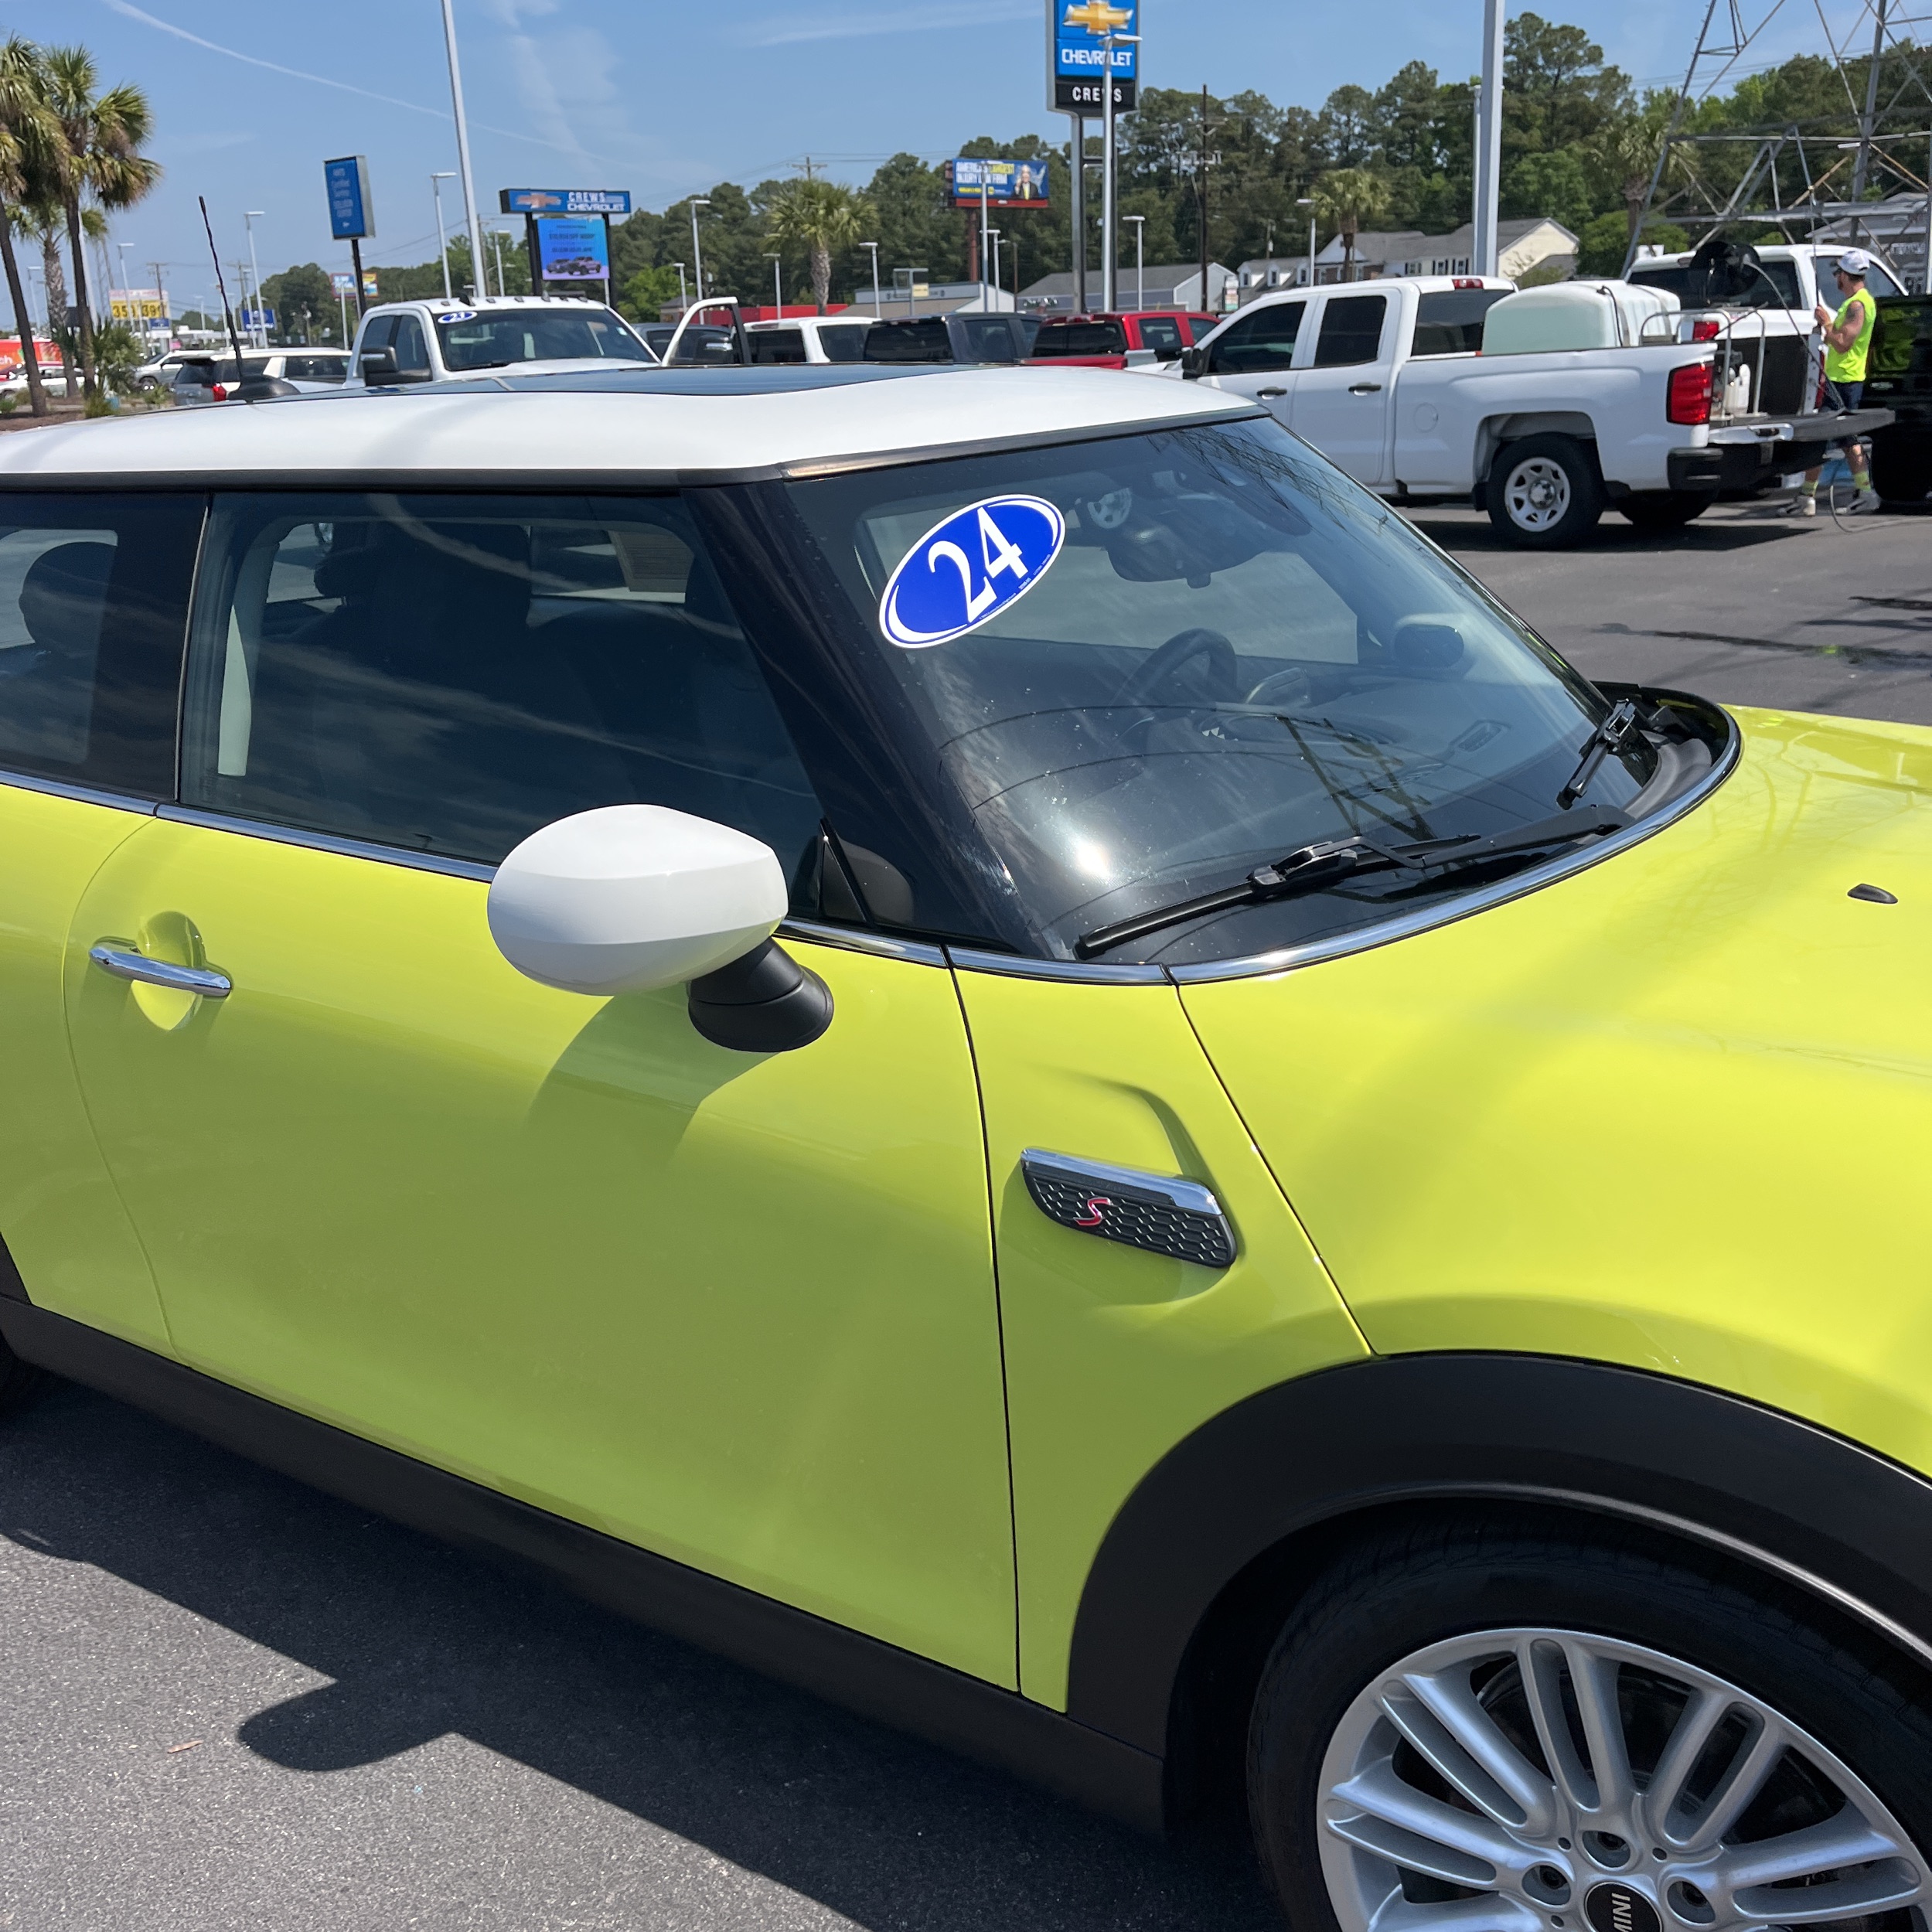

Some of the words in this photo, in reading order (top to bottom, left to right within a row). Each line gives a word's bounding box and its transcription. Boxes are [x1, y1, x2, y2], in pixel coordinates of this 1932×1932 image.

[1061, 49, 1132, 66] CHEVRLET
[1072, 87, 1122, 102] CRES
[568, 192, 605, 203] CREWS
[929, 506, 1028, 623] 24
[1073, 1198, 1113, 1226] S
